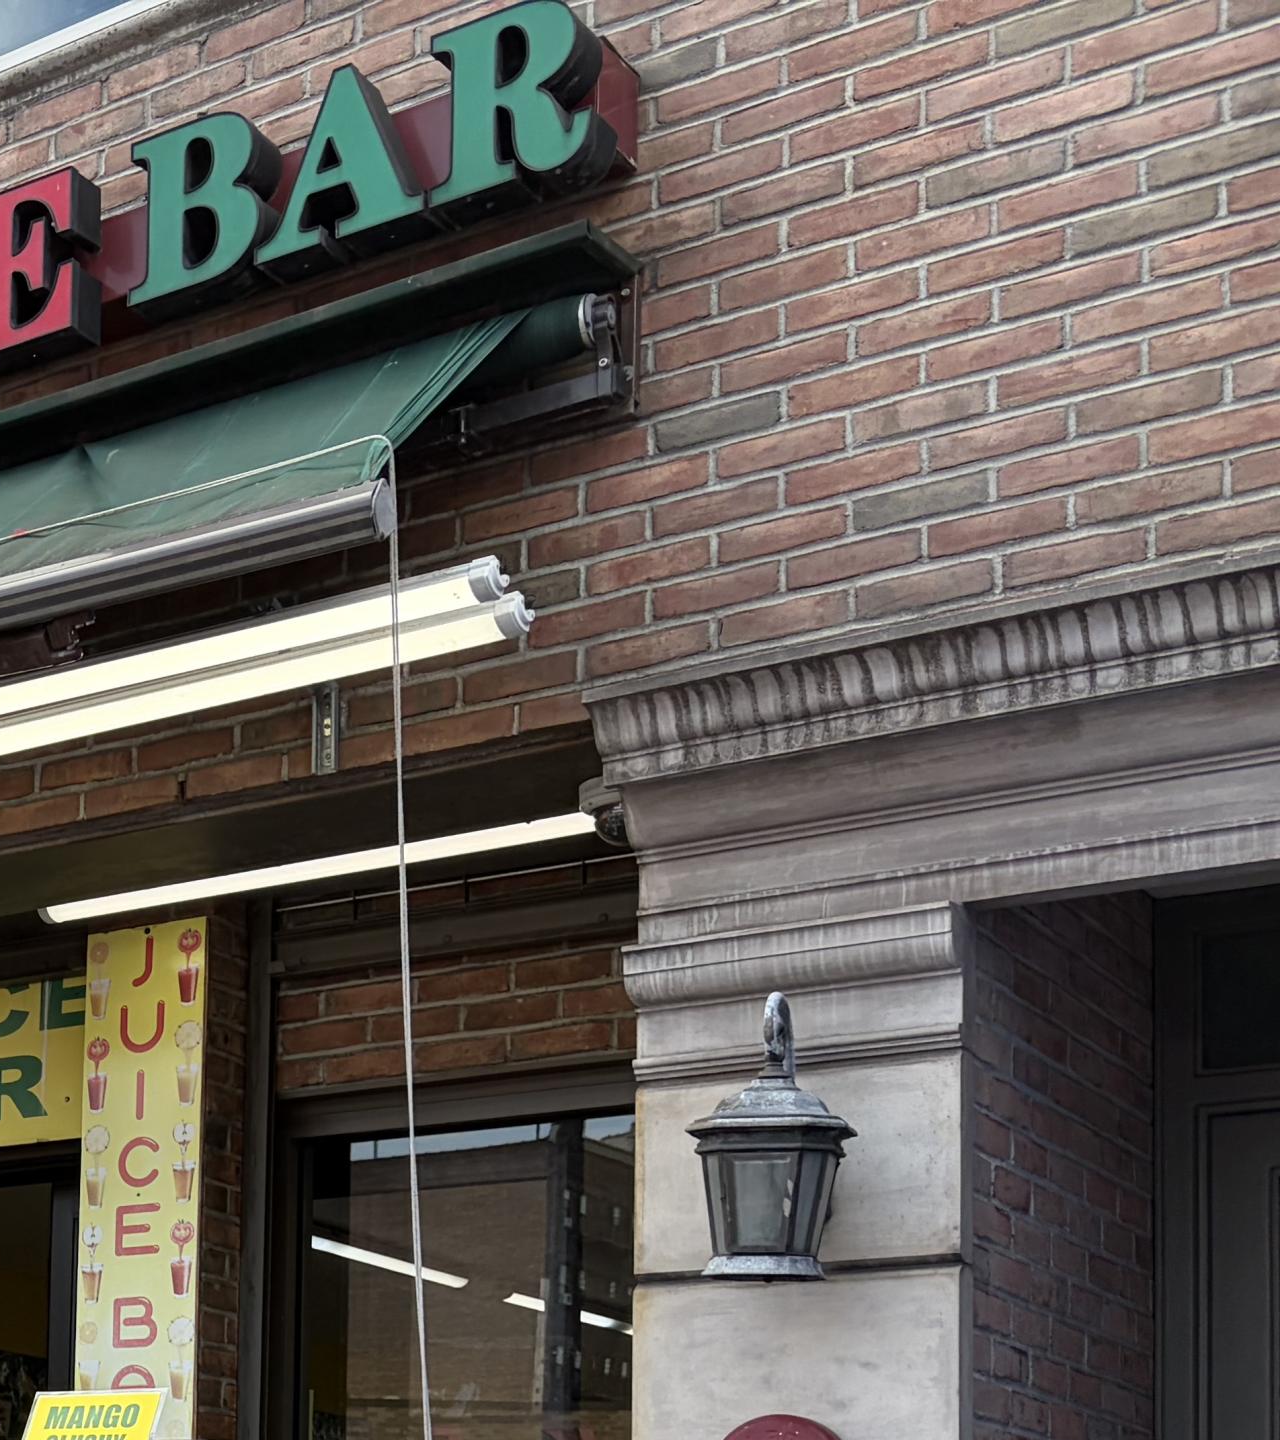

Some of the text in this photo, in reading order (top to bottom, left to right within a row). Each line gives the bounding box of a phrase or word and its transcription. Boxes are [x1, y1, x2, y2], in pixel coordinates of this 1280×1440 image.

[127, 0, 594, 307] BAR
[115, 936, 164, 1256] JUICE
[44, 1403, 140, 1430] MANGO
